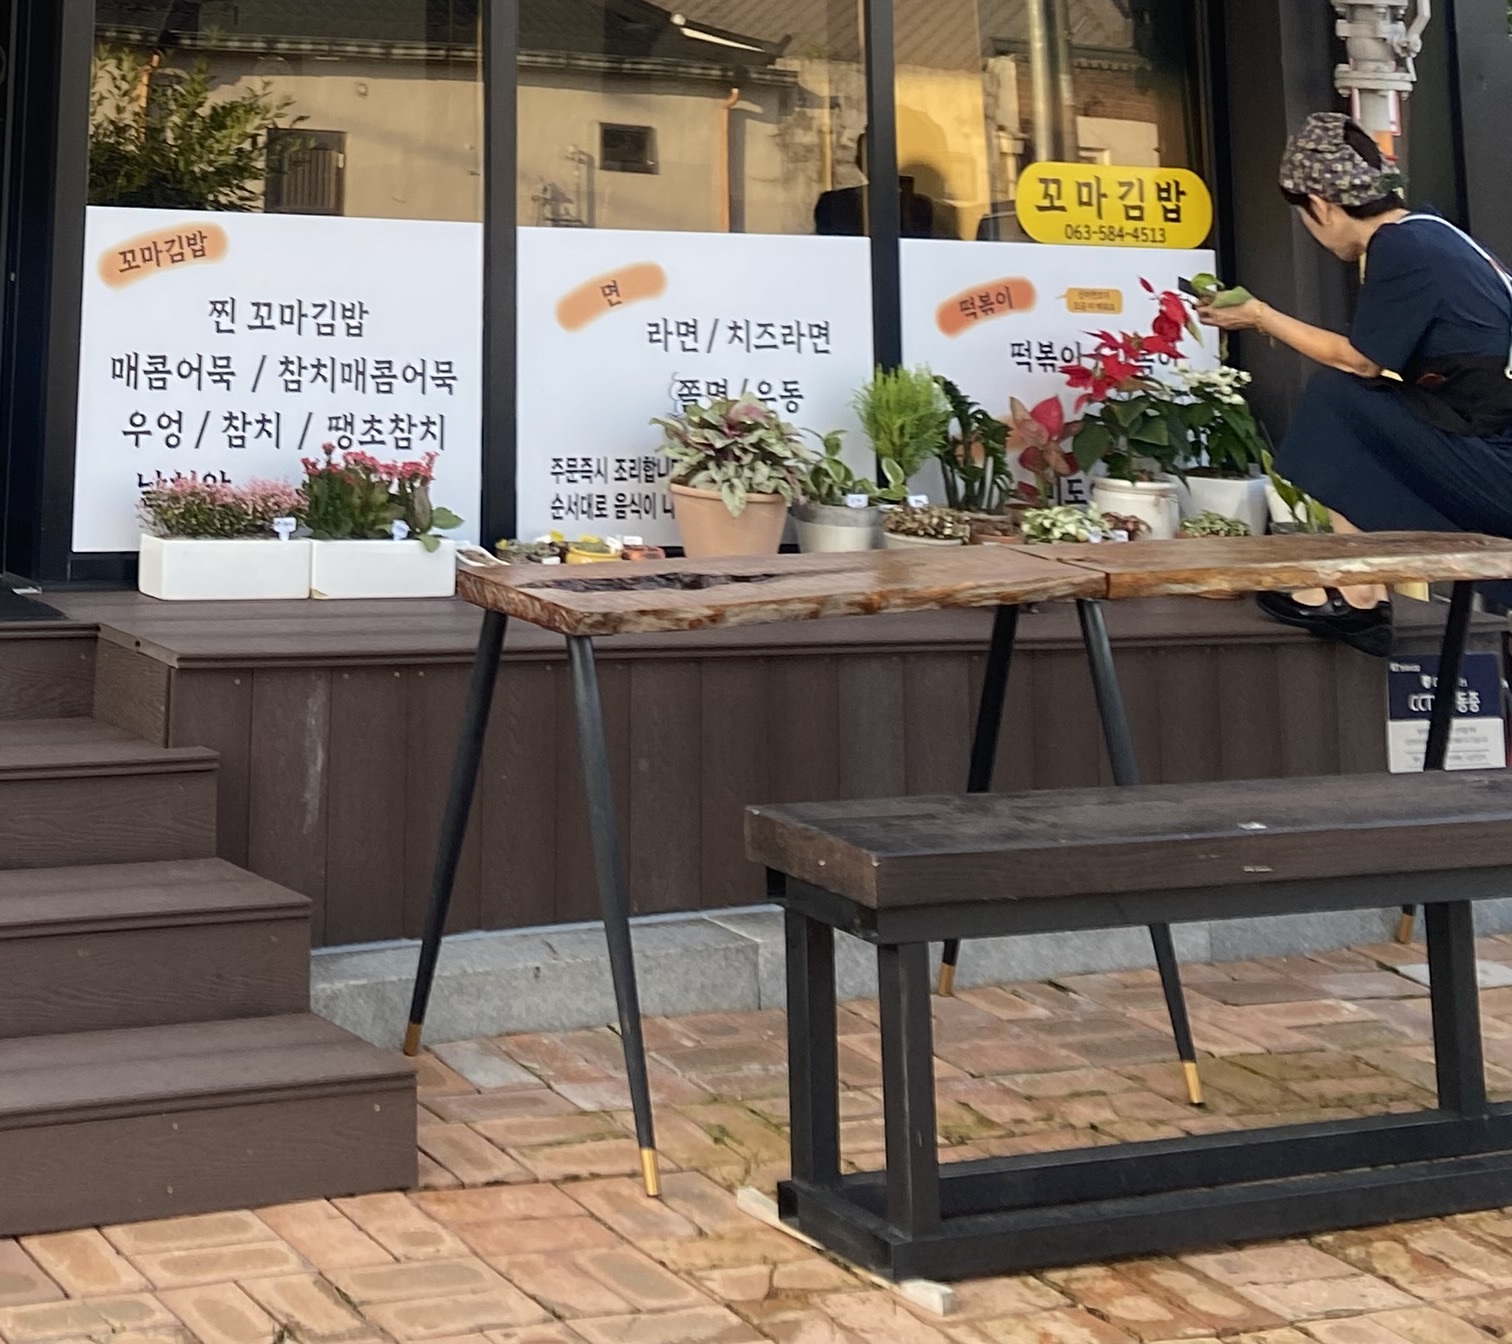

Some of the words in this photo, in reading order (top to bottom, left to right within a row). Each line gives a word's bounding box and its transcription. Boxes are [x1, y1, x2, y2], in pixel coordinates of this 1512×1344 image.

[1035, 175, 1187, 225] 꼬마김밥
[1064, 223, 1167, 244] 063-584-4513
[118, 230, 208, 273] 꼬마김밥
[600, 279, 623, 307] 면
[958, 285, 1013, 319] 떡볶이
[208, 296, 236, 335] 찐
[246, 298, 370, 337] 꼬마김밥
[646, 317, 700, 354] 라면
[727, 318, 832, 355] 치즈라면
[110, 351, 237, 392] 매콤어묵
[277, 354, 458, 396] 참치매콤어묵
[757, 379, 804, 414] 우동
[122, 410, 184, 449] 우엉
[221, 411, 281, 450] 참치
[327, 412, 446, 451] 땡초참치
[550, 457, 608, 484] 주문즉시
[550, 491, 609, 520] 순서대로
[614, 492, 657, 520] 음식이
[1408, 693, 1436, 712] CCT
